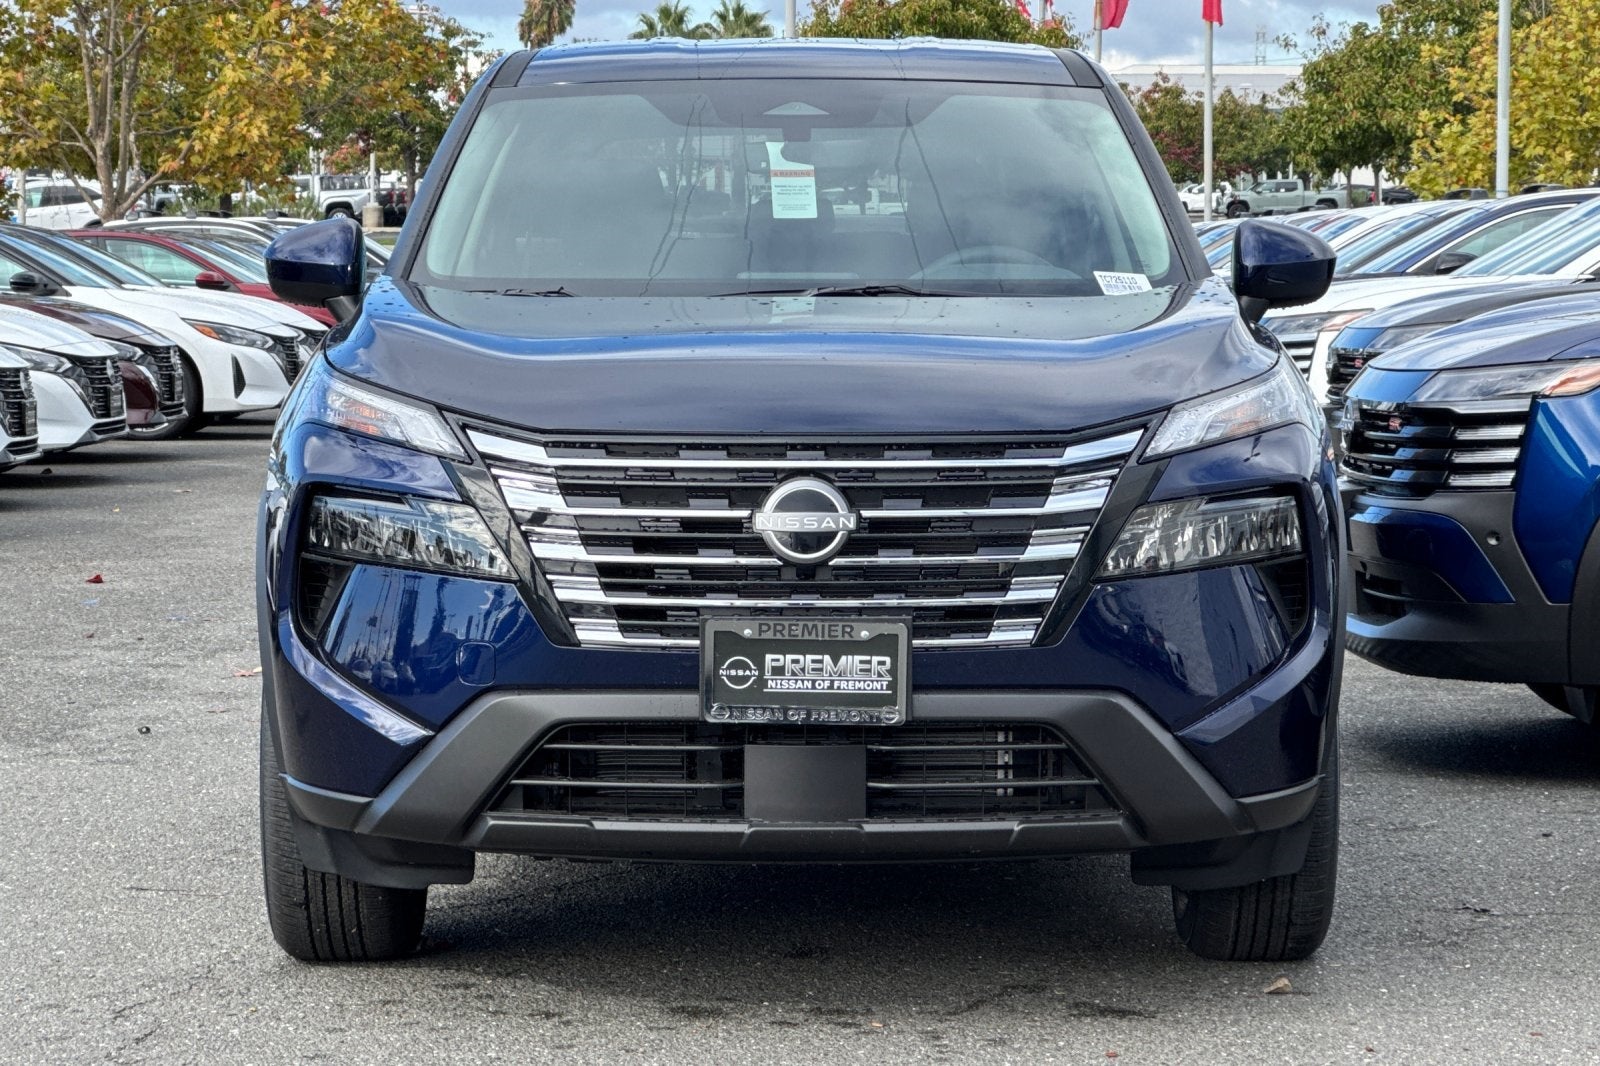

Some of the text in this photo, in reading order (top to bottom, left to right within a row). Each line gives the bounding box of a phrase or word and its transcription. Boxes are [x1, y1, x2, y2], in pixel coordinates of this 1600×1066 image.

[759, 516, 854, 529] NISSAN
[758, 622, 855, 638] PREMIER
[765, 653, 891, 678] PREMIER
[767, 680, 889, 691] NISSAN OF FREMONT
[731, 707, 880, 723] NISSAN OF FREMONT
